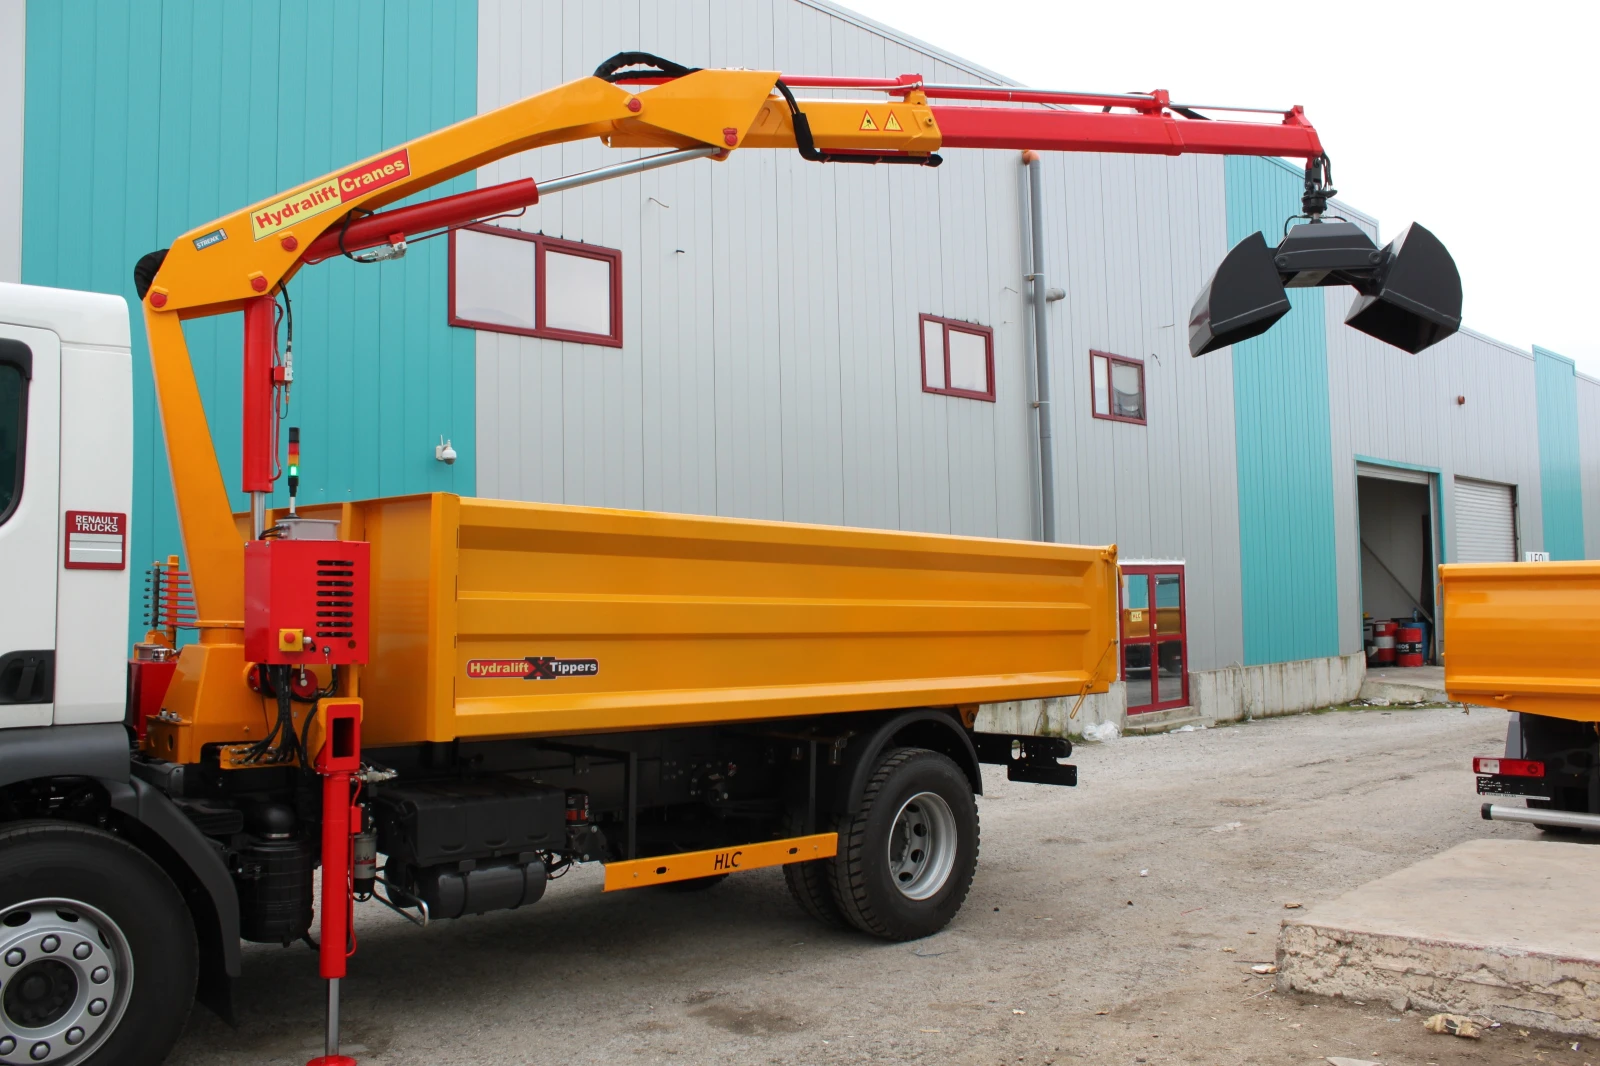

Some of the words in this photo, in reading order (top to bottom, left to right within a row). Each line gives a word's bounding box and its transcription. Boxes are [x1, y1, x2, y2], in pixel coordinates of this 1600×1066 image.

[255, 185, 339, 229] Hydralift
[340, 159, 405, 193] Cranes
[75, 514, 119, 525] RENAULT
[75, 523, 118, 532] TRUCKS
[470, 662, 529, 675] Hydralift
[549, 662, 597, 674] Tippers
[714, 851, 743, 870] HLC
